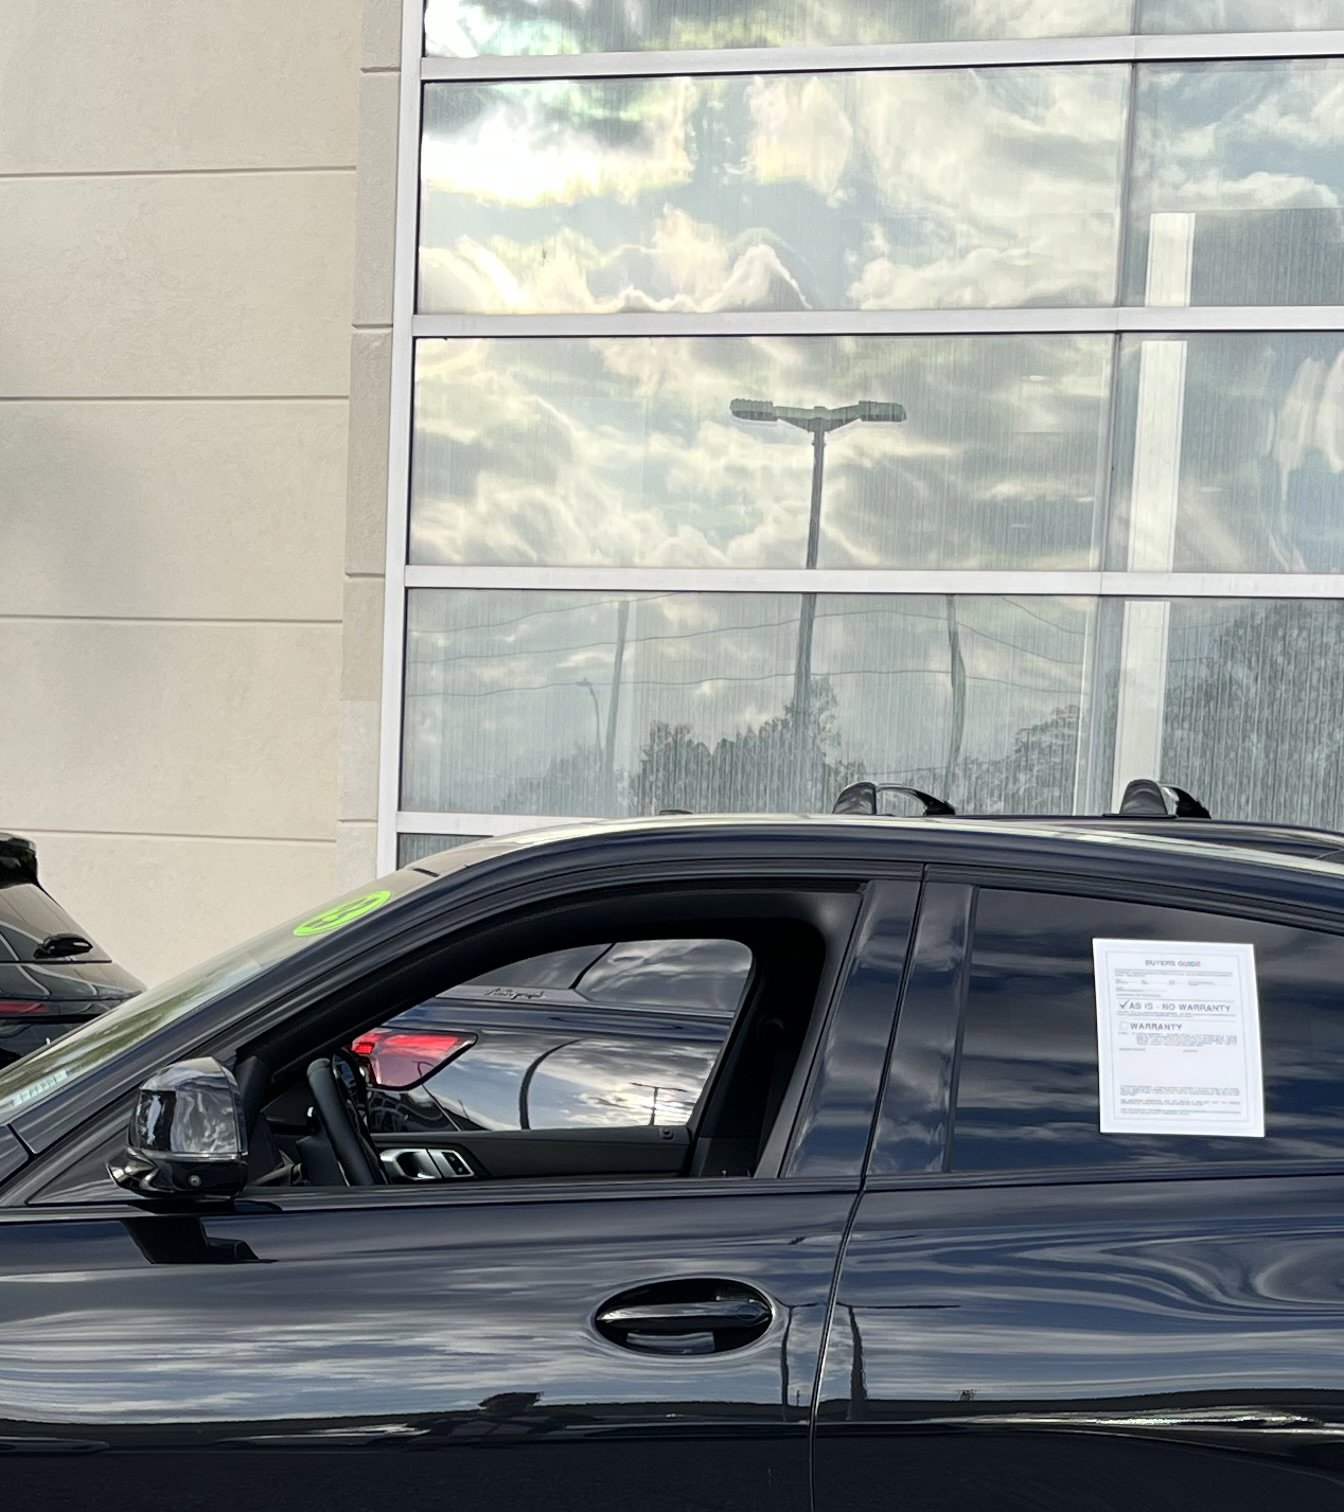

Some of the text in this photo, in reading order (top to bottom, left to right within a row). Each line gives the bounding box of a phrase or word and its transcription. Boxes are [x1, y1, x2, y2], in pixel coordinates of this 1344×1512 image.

[1129, 1002, 1142, 1010] AS
[1144, 1002, 1153, 1010] IS
[1162, 1003, 1176, 1011] NO
[1178, 1003, 1231, 1012] WARRANTY
[1130, 1023, 1183, 1031] WARRANTY
